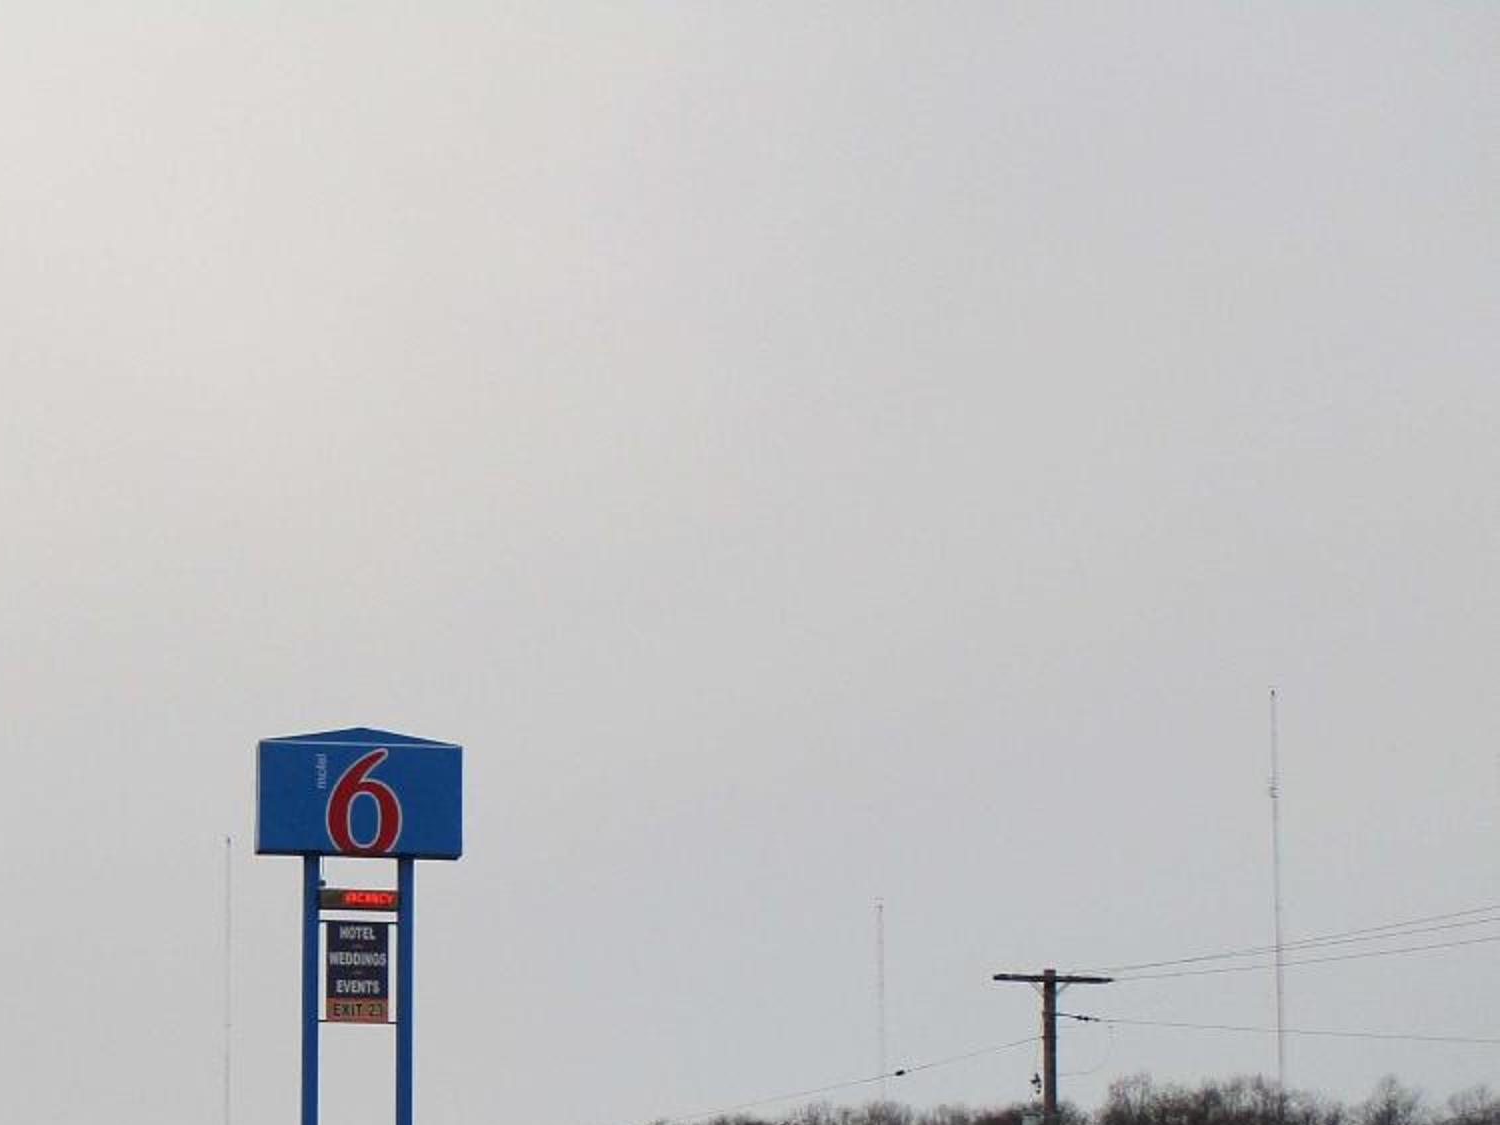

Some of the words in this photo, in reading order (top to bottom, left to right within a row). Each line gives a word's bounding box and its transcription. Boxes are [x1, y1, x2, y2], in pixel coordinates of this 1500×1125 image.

[326, 749, 403, 853] 6
[344, 892, 394, 905] VACANCY
[330, 952, 387, 967] WEDDINGS
[336, 979, 381, 994] EVENTS
[333, 1003, 362, 1018] EXIT
